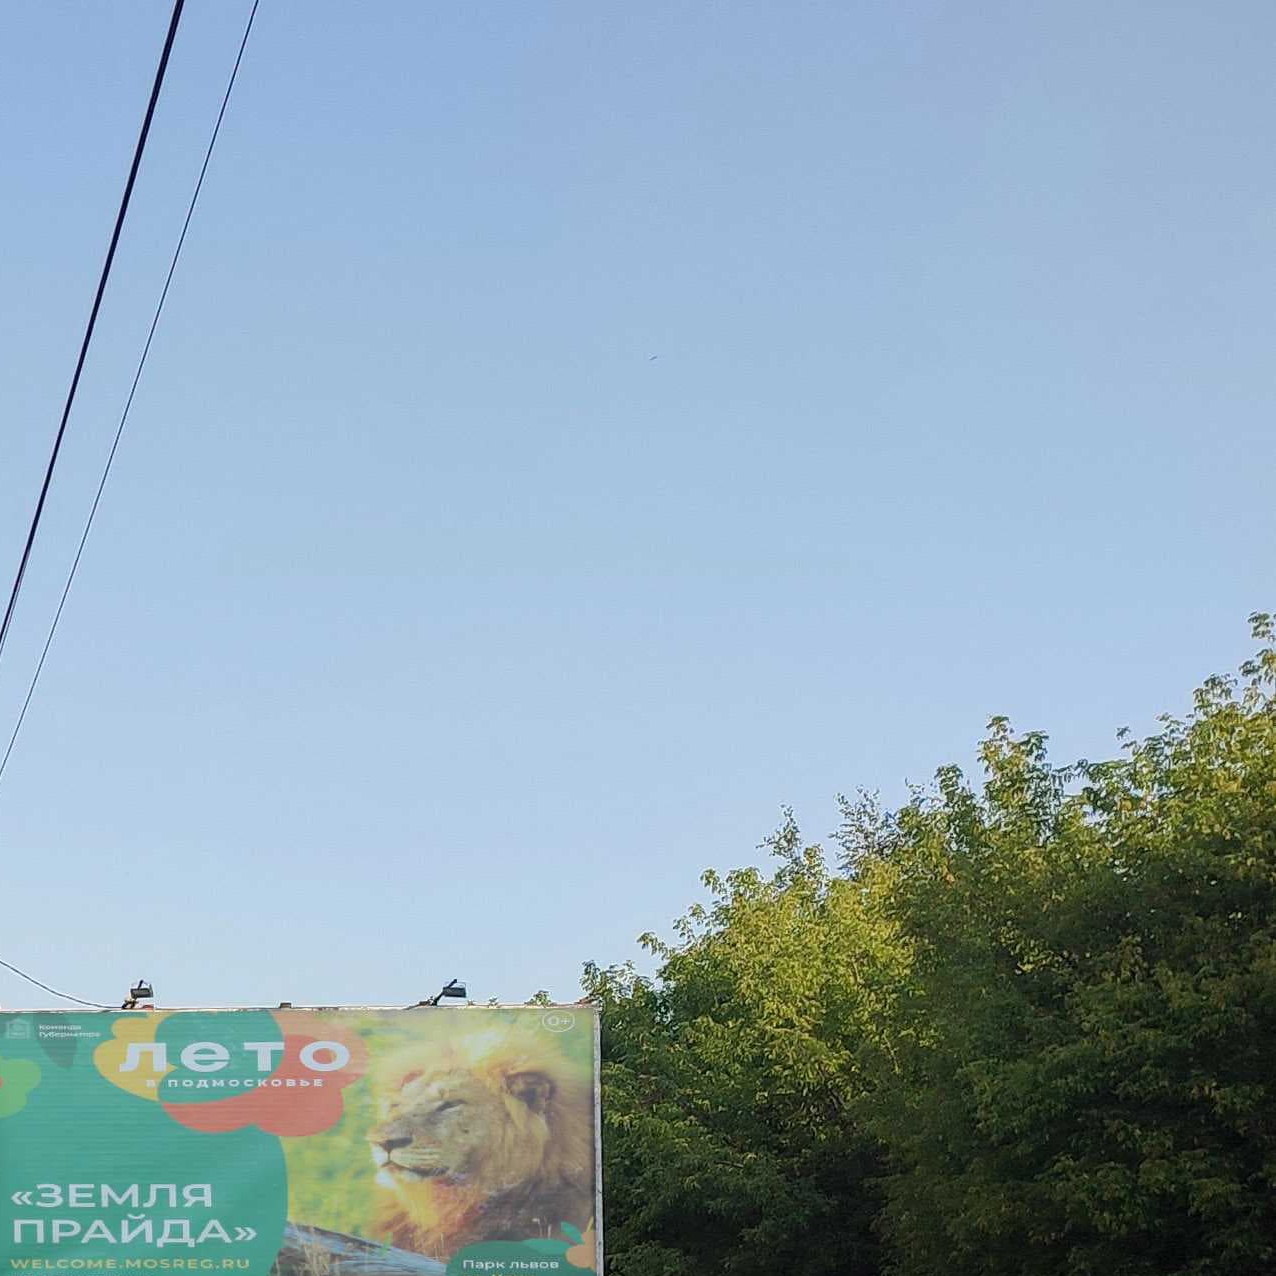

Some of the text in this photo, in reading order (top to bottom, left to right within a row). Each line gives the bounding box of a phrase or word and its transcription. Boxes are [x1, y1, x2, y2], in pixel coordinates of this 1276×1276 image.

[10, 1183, 212, 1209] «ЗЕМЛЯ
[12, 1213, 258, 1249] ПРАЙДА»
[9, 1258, 251, 1270] WELCOME.MOSREG.RU
[462, 1260, 560, 1271] Парк львов
